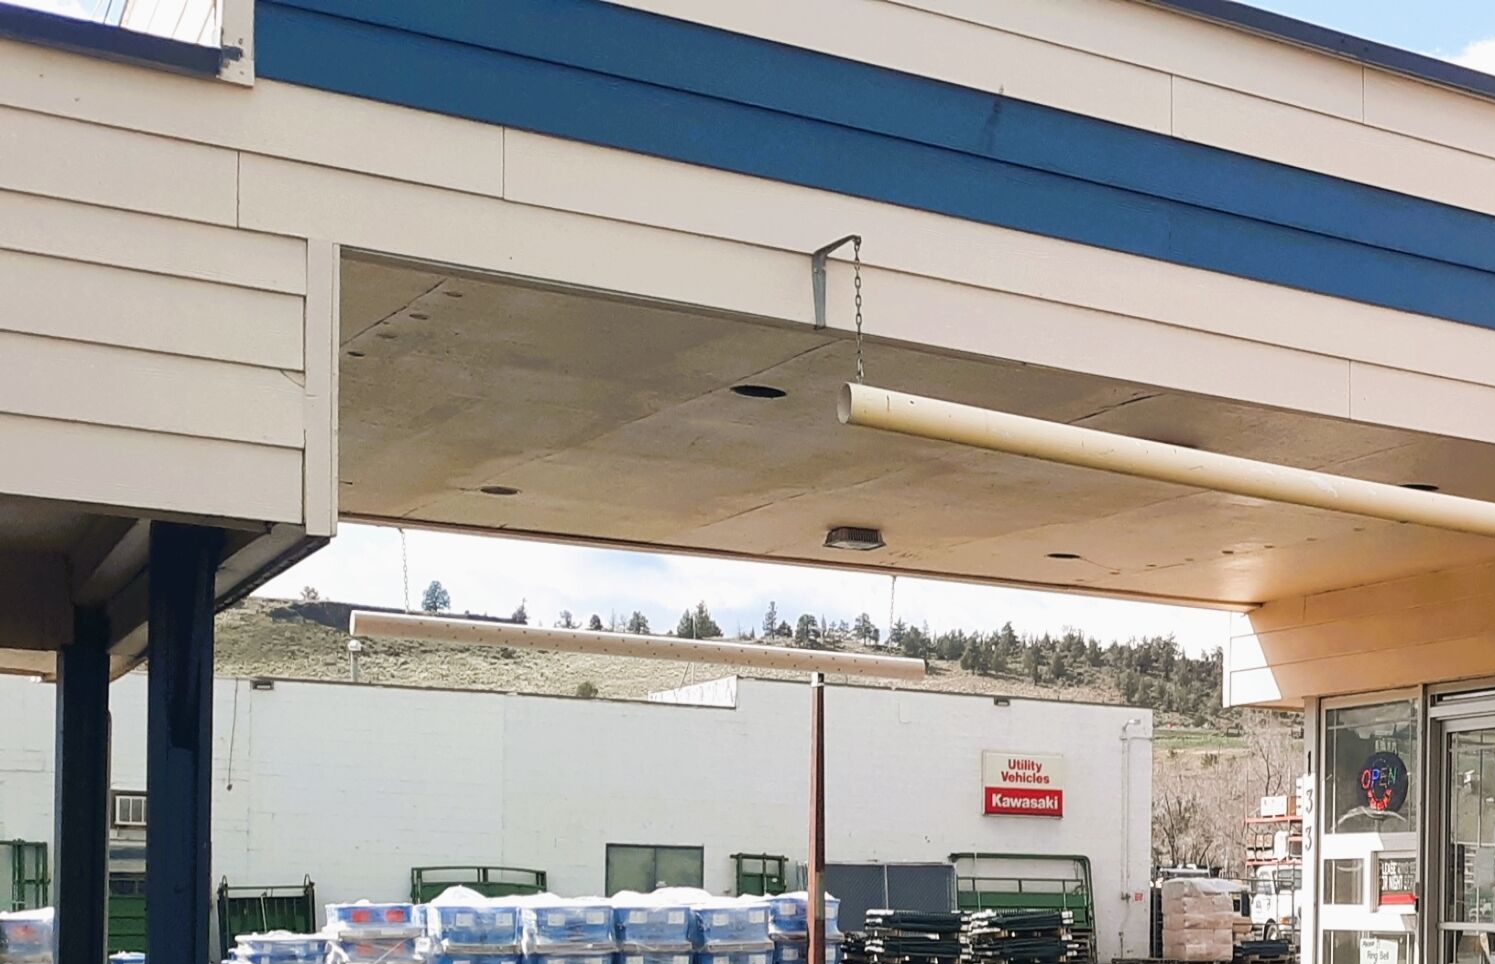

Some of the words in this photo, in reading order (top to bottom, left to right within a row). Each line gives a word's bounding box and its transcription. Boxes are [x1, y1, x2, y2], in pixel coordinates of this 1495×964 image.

[1008, 759, 1042, 773] Utility
[1001, 771, 1050, 784] Vehicles
[1362, 767, 1397, 789] OPEN
[992, 793, 1058, 809] Kawasaki
